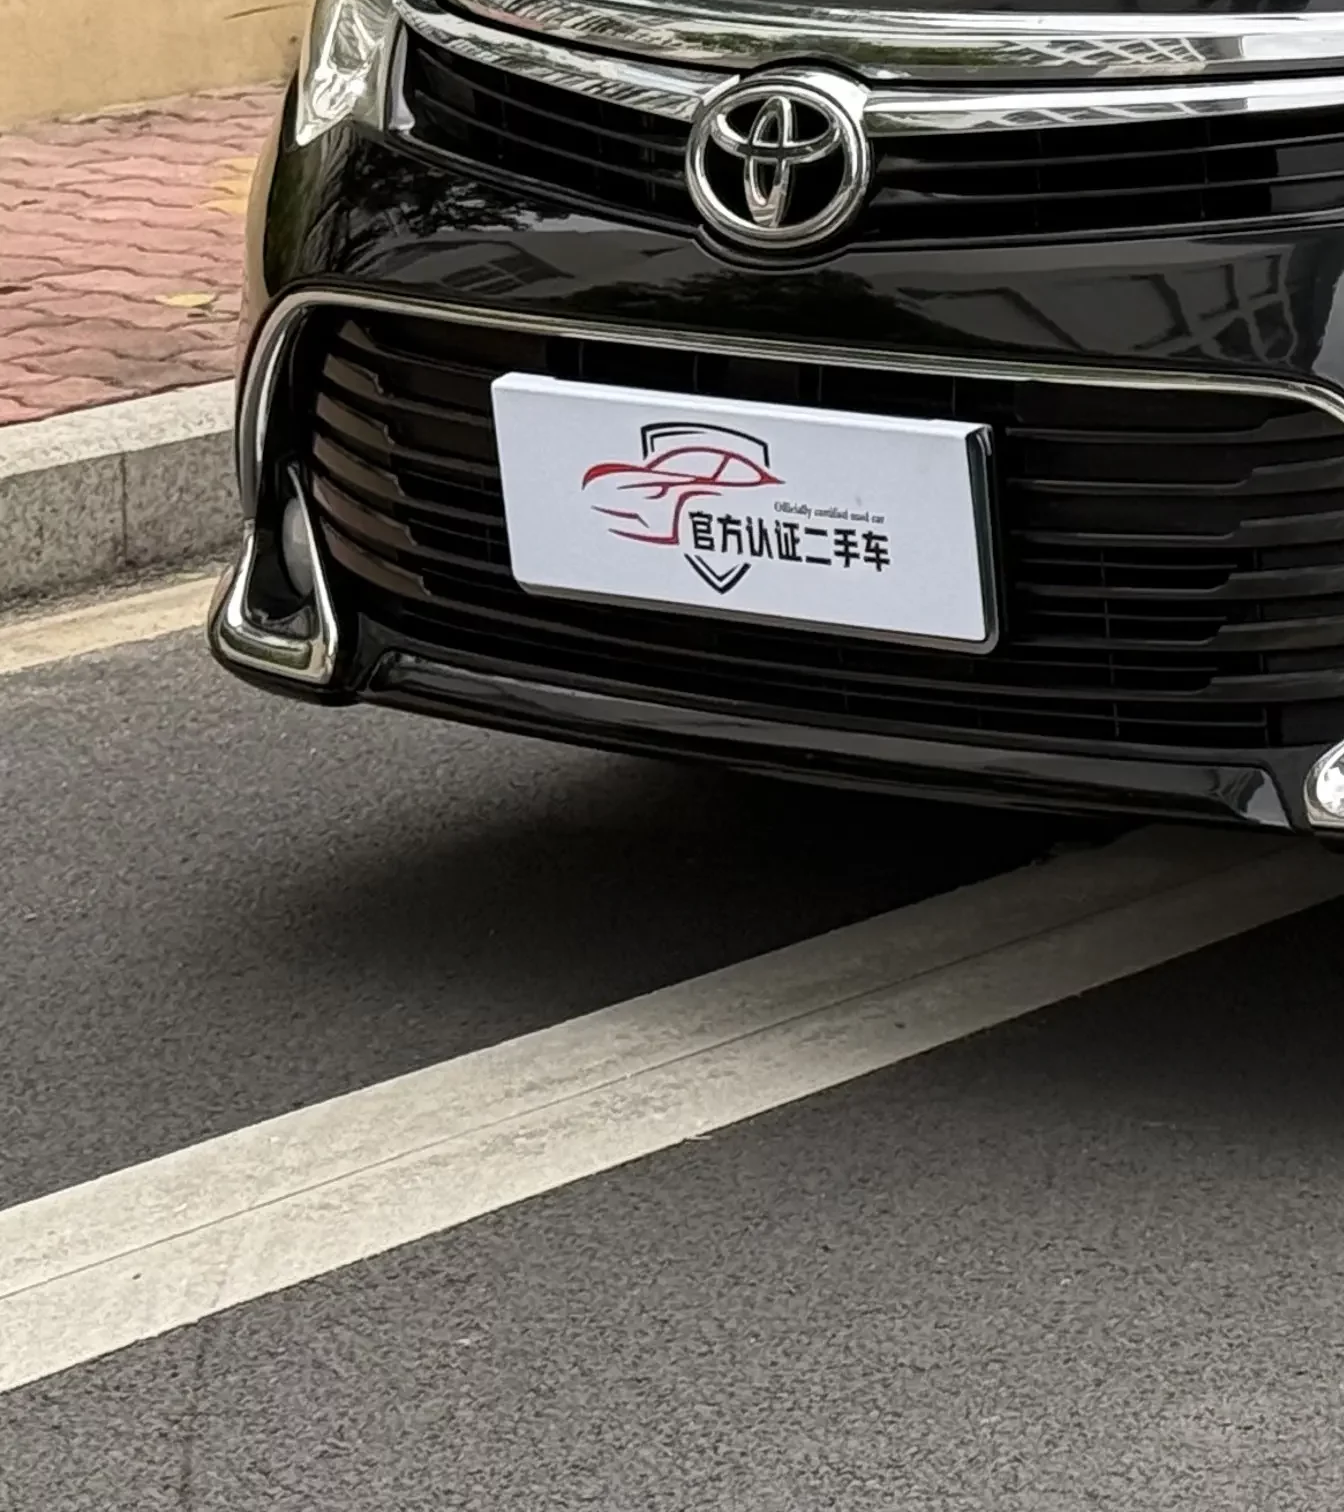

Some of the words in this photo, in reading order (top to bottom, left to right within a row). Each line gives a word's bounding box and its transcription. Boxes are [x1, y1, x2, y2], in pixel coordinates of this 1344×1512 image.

[689, 511, 890, 572] 官方认证二手车
